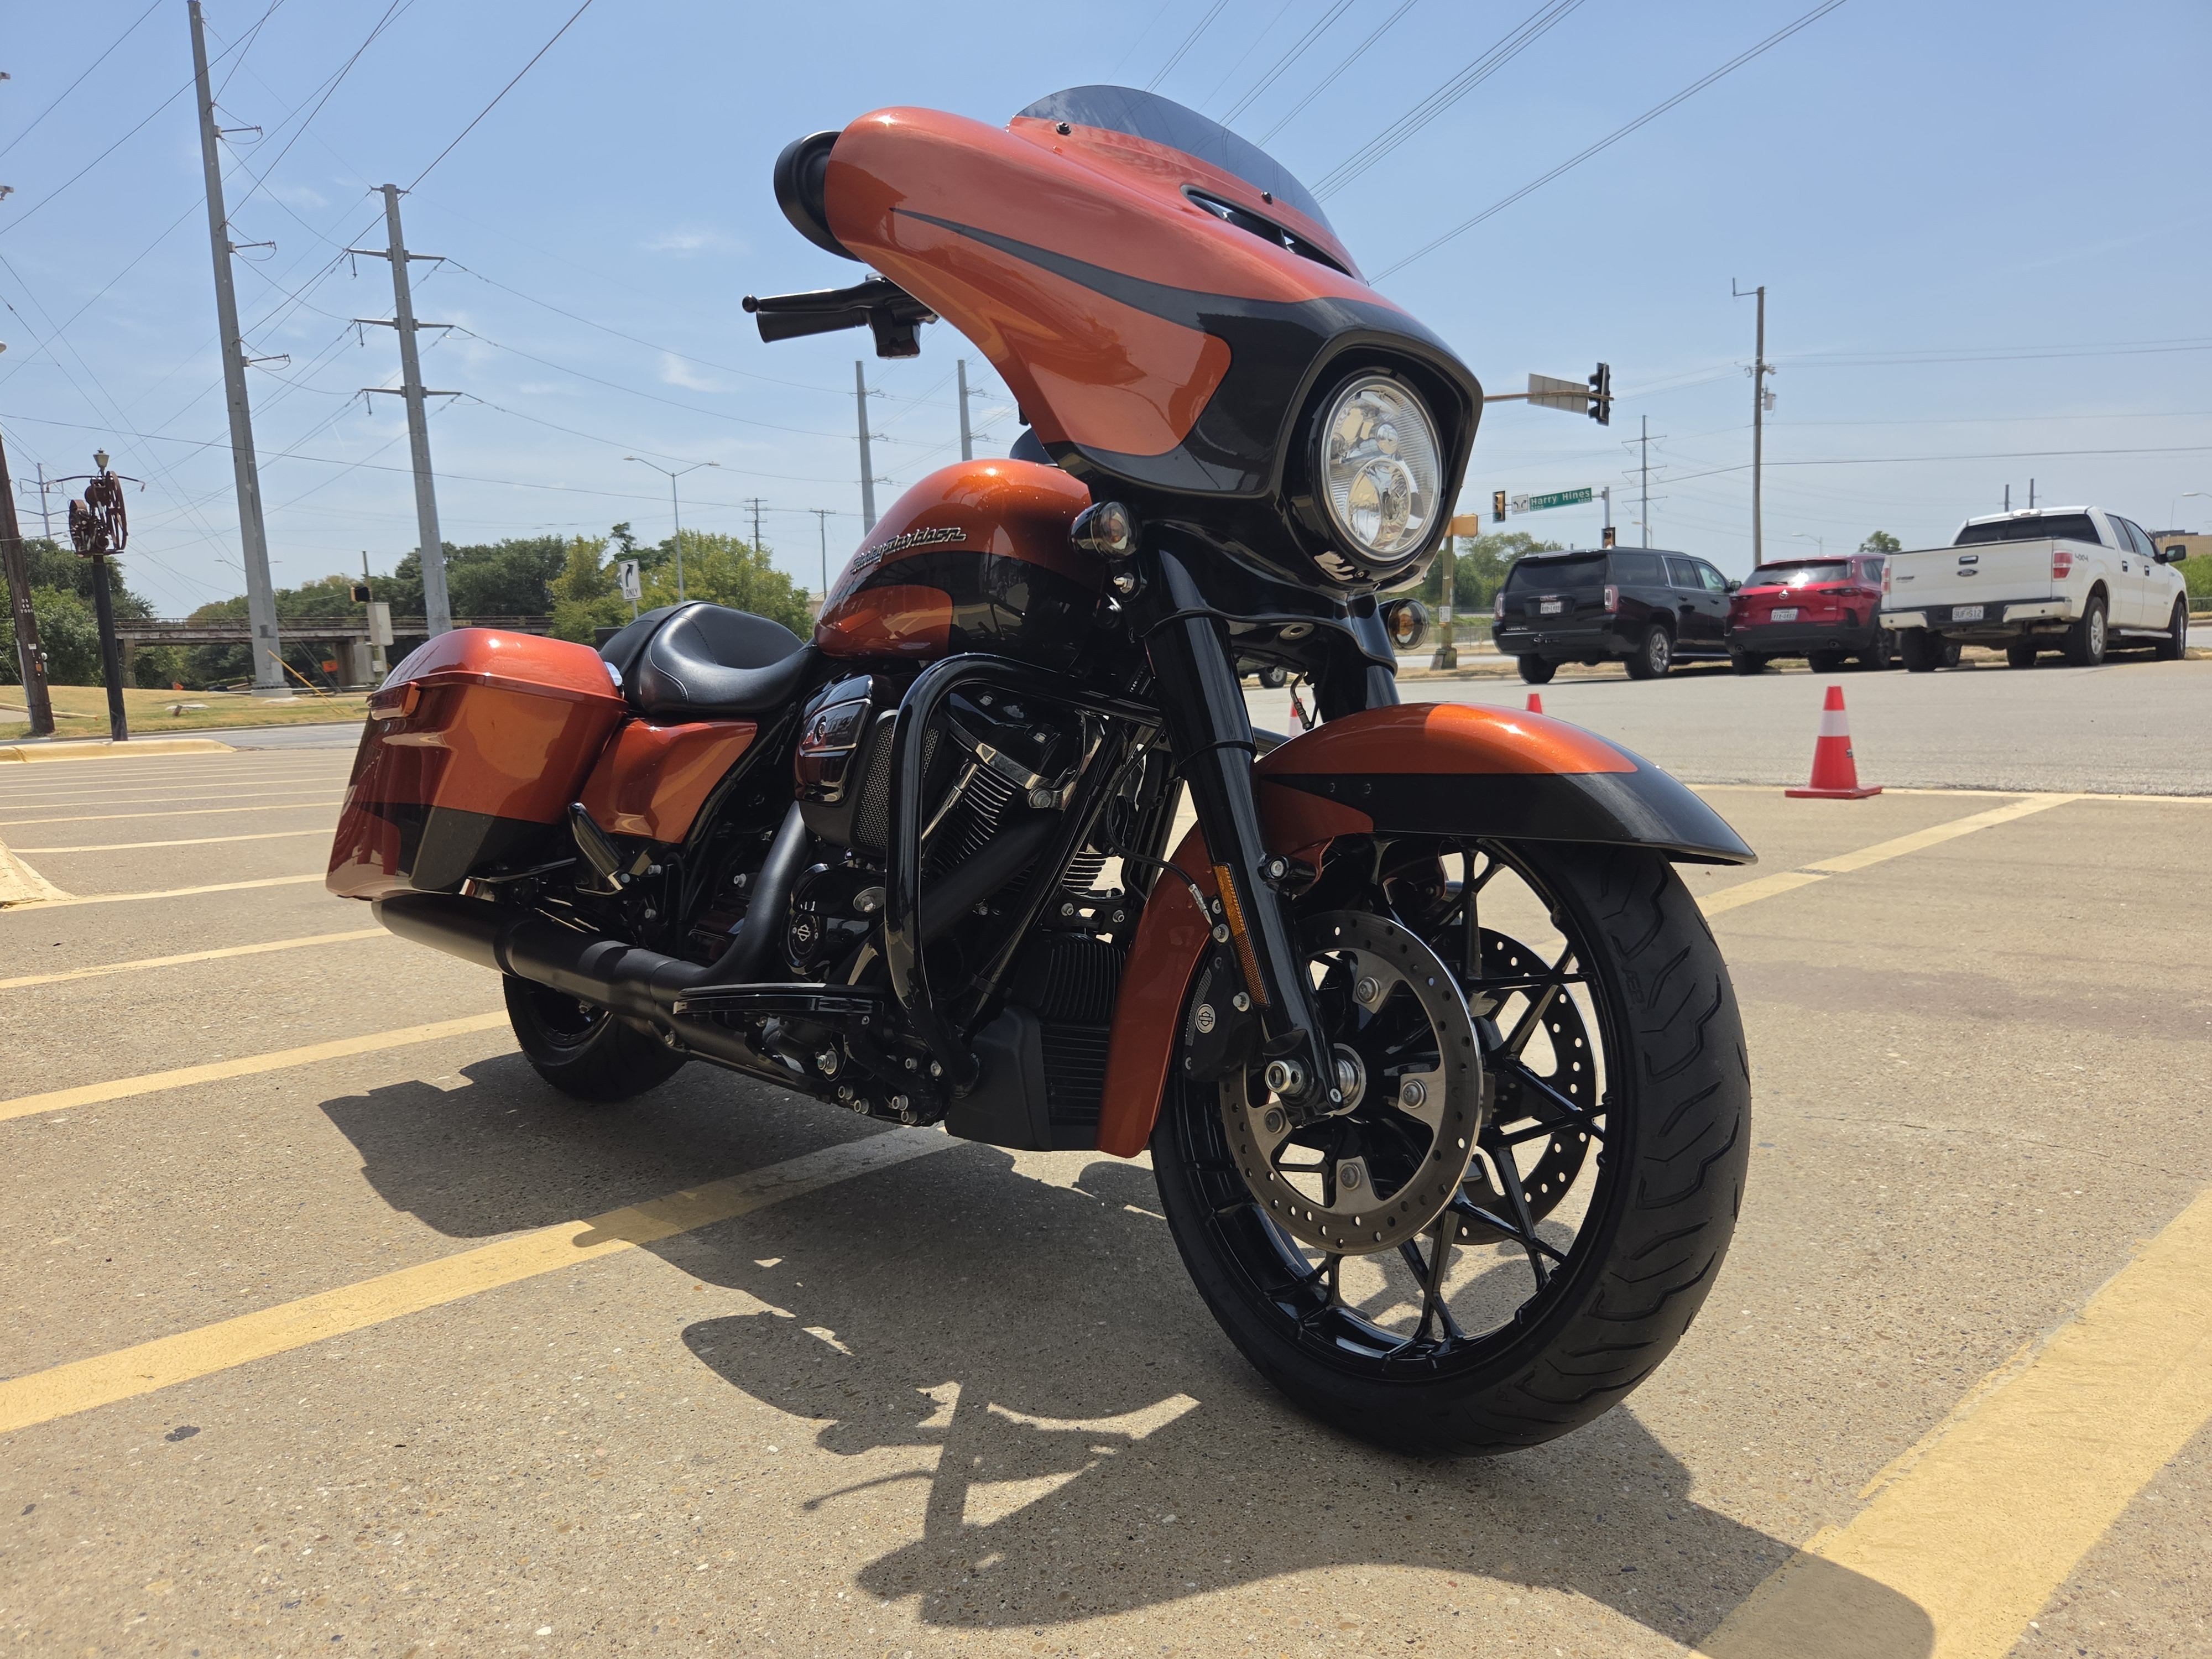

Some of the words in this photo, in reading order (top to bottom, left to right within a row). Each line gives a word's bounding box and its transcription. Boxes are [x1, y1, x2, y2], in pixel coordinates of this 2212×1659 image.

[1531, 495, 1557, 505] Harry
[1562, 491, 1590, 500] Hines
[626, 588, 638, 598] ONLY
